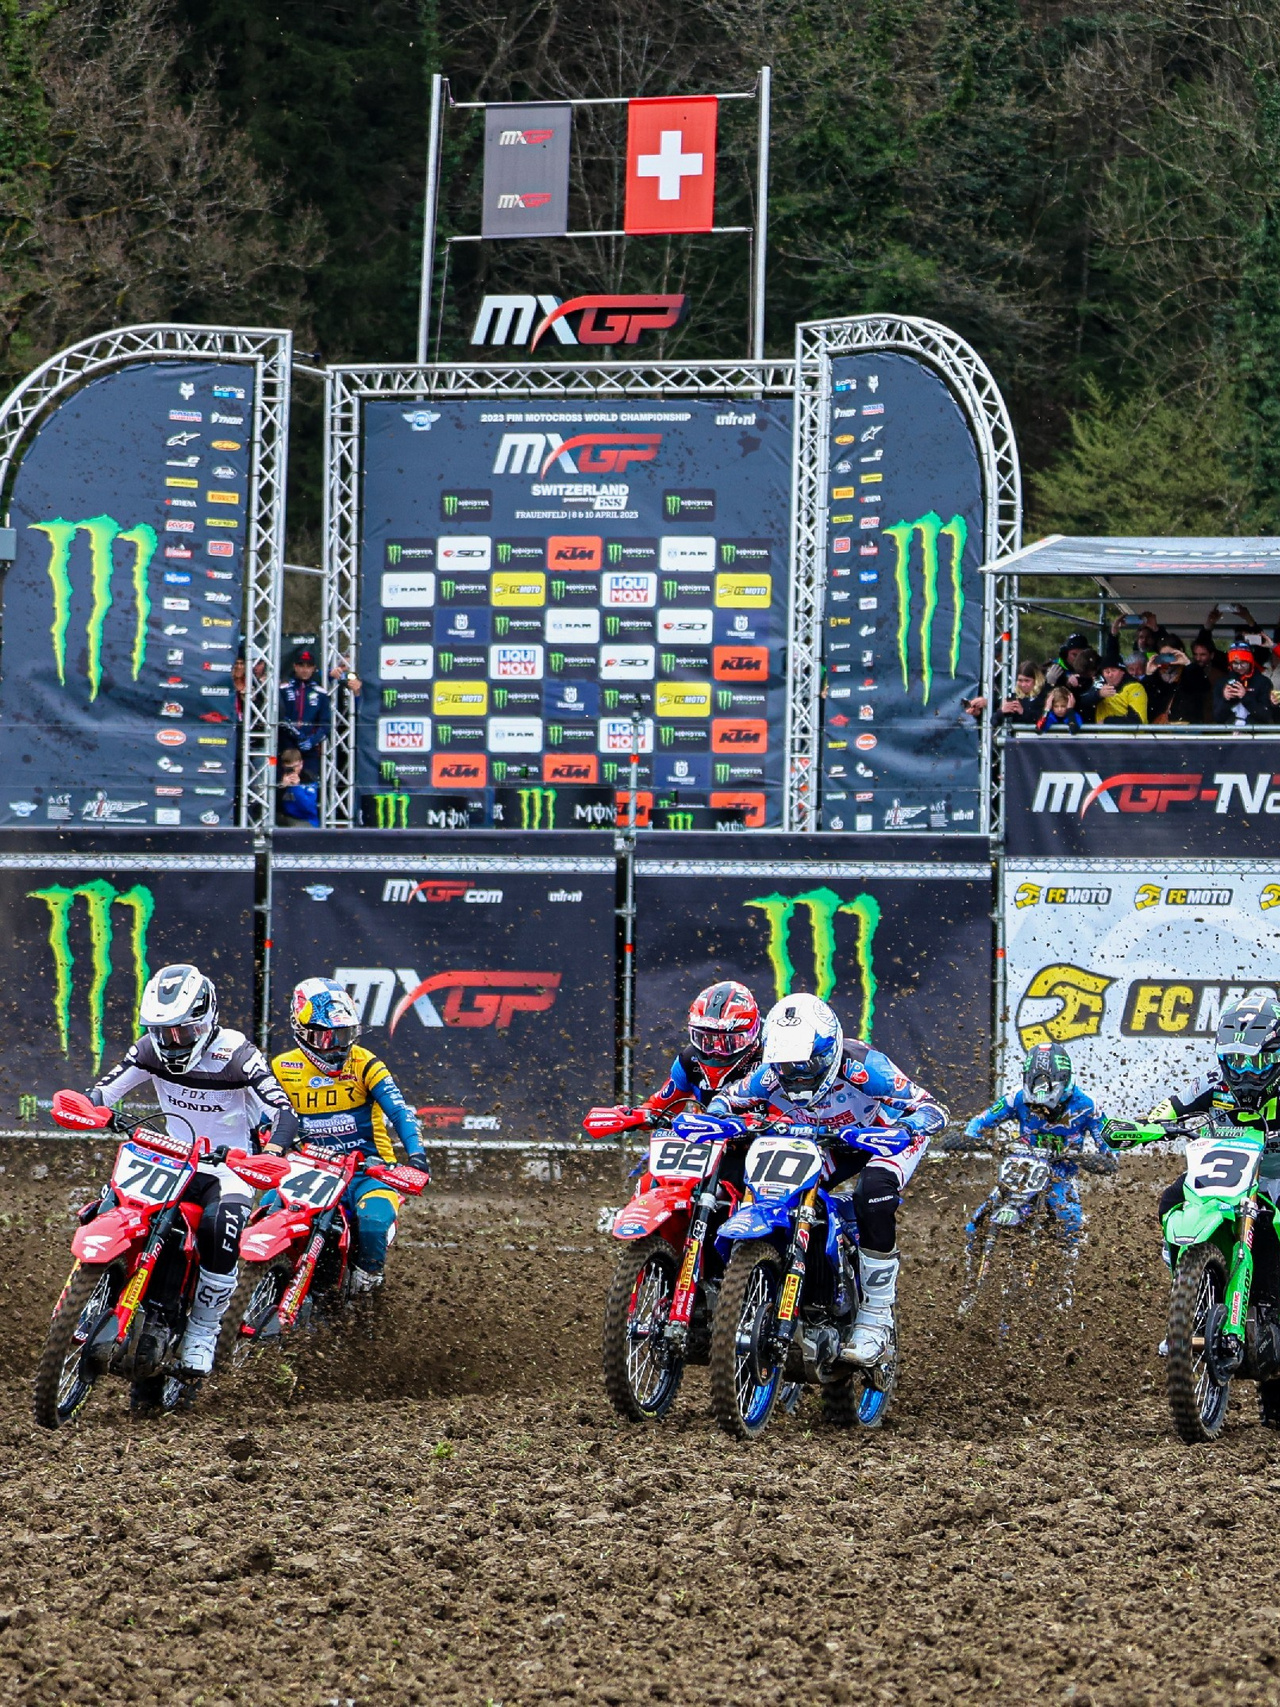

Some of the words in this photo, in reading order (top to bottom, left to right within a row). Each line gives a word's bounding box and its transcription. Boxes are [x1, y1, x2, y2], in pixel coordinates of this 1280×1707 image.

[500, 130, 553, 145] MXGP
[498, 193, 551, 208] MXGP
[470, 294, 685, 354] MXGP
[481, 413, 504, 422] 2023
[506, 413, 523, 422] FIM
[526, 413, 583, 422] MOTOCROSS
[585, 413, 618, 422] WORLD
[620, 413, 692, 422] CHAMPIONSHIP
[493, 433, 662, 480] MXGP
[531, 484, 629, 496] SWITZERLAND
[515, 511, 567, 519] FRAUENFELD
[572, 511, 578, 519] 8
[585, 511, 594, 519] 10
[595, 511, 619, 519] APRIL
[620, 511, 638, 519] 2023
[555, 546, 595, 560] KTM
[611, 577, 648, 589] LIQUI
[611, 590, 648, 602] MOLY
[499, 650, 536, 662] LIQUI
[499, 663, 536, 675] MOLY
[721, 657, 762, 671] KTM
[387, 722, 423, 734] LIQUI
[386, 735, 423, 748] MOLY
[609, 736, 645, 748] MOY
[719, 729, 760, 743] KTM
[440, 765, 479, 778] KTM
[552, 764, 590, 778] KTM
[333, 967, 562, 1039] MXGP
[181, 1088, 208, 1099] FOX
[168, 1095, 225, 1112] HONDA
[656, 1141, 712, 1172] 92
[750, 1150, 815, 1185] 10
[1195, 1150, 1250, 1189] 3
[119, 1159, 181, 1200] 70
[281, 1171, 339, 1205] 41
[222, 1210, 239, 1252] FOX
